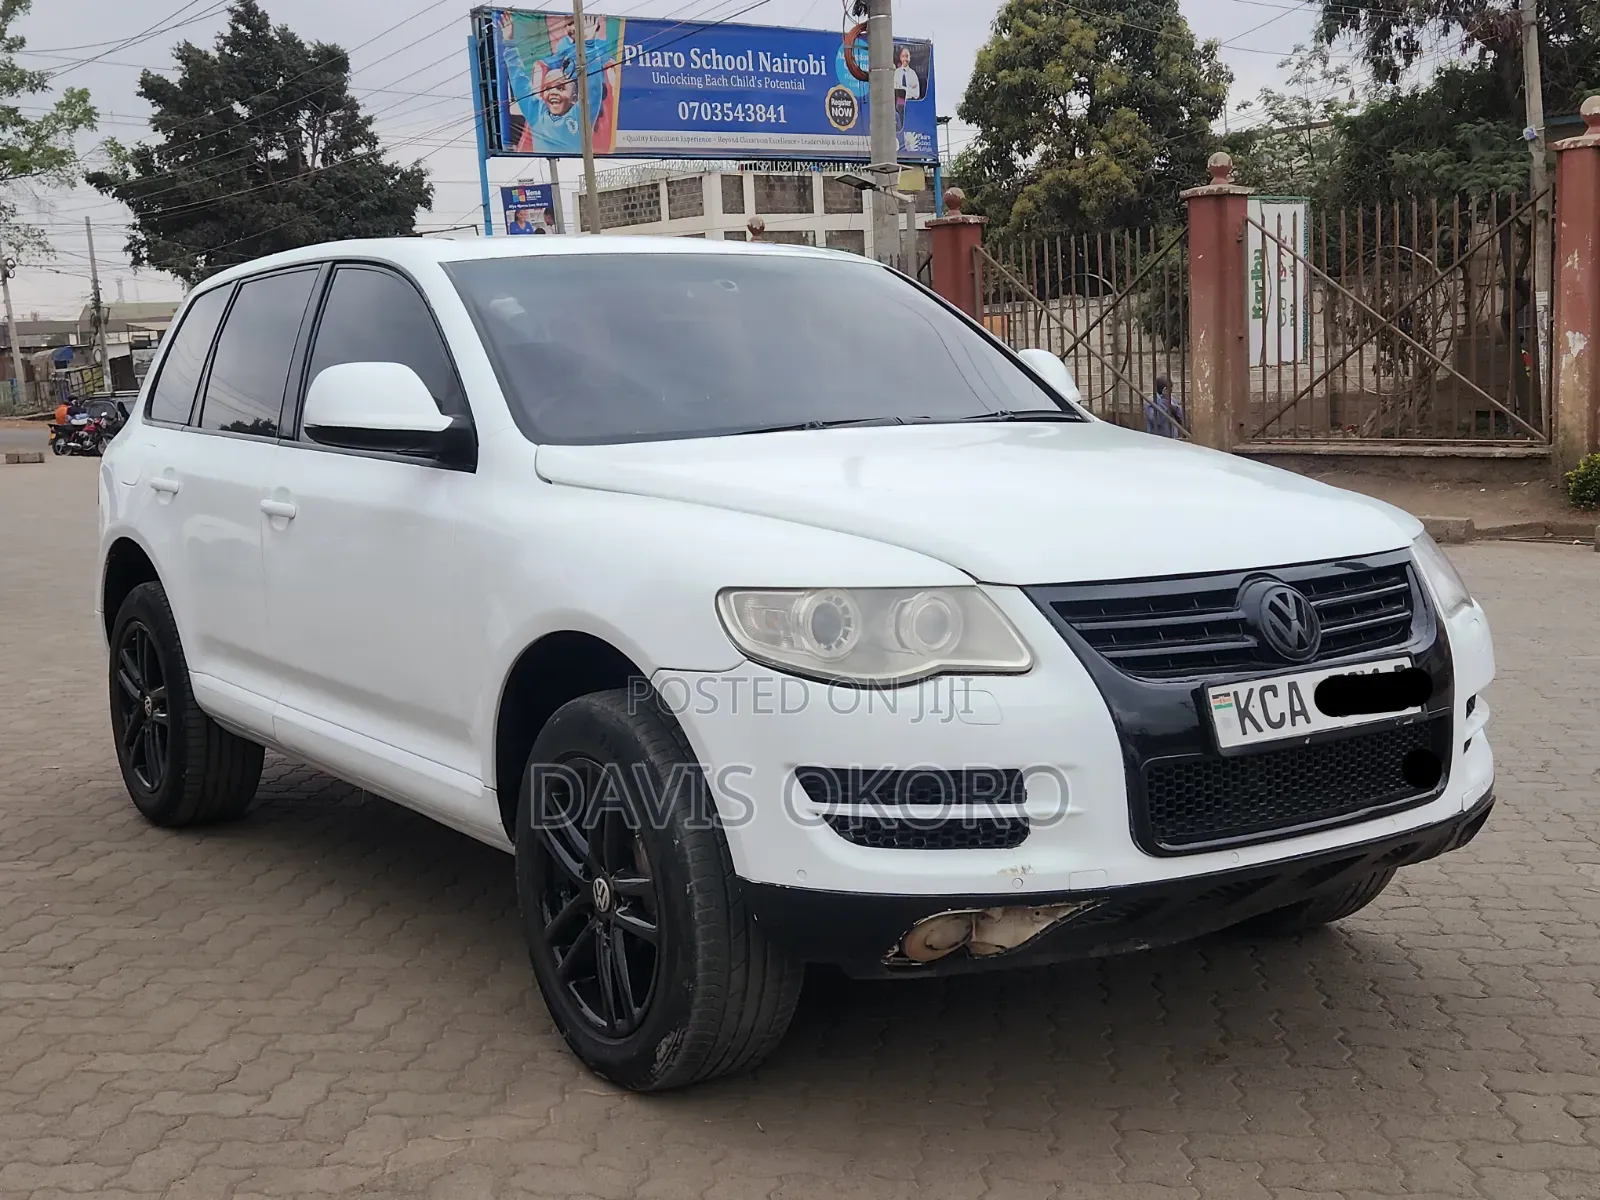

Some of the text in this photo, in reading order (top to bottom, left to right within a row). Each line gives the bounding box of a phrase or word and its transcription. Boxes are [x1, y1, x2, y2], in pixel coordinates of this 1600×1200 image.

[623, 44, 685, 68] Pharo
[690, 47, 754, 71] School
[758, 51, 827, 76] Nairobi
[651, 72, 806, 90] Unlocking Each Child's Potential
[678, 101, 788, 123] 0703543841
[830, 98, 852, 108] Register
[831, 108, 853, 118] NOW
[626, 135, 648, 144] Quality
[649, 135, 679, 143] Education
[680, 136, 712, 144] Experience
[717, 136, 739, 144] Beyond
[801, 138, 830, 147] Leadership
[1251, 248, 1263, 320] Karibu
[1232, 681, 1312, 736] KCA
